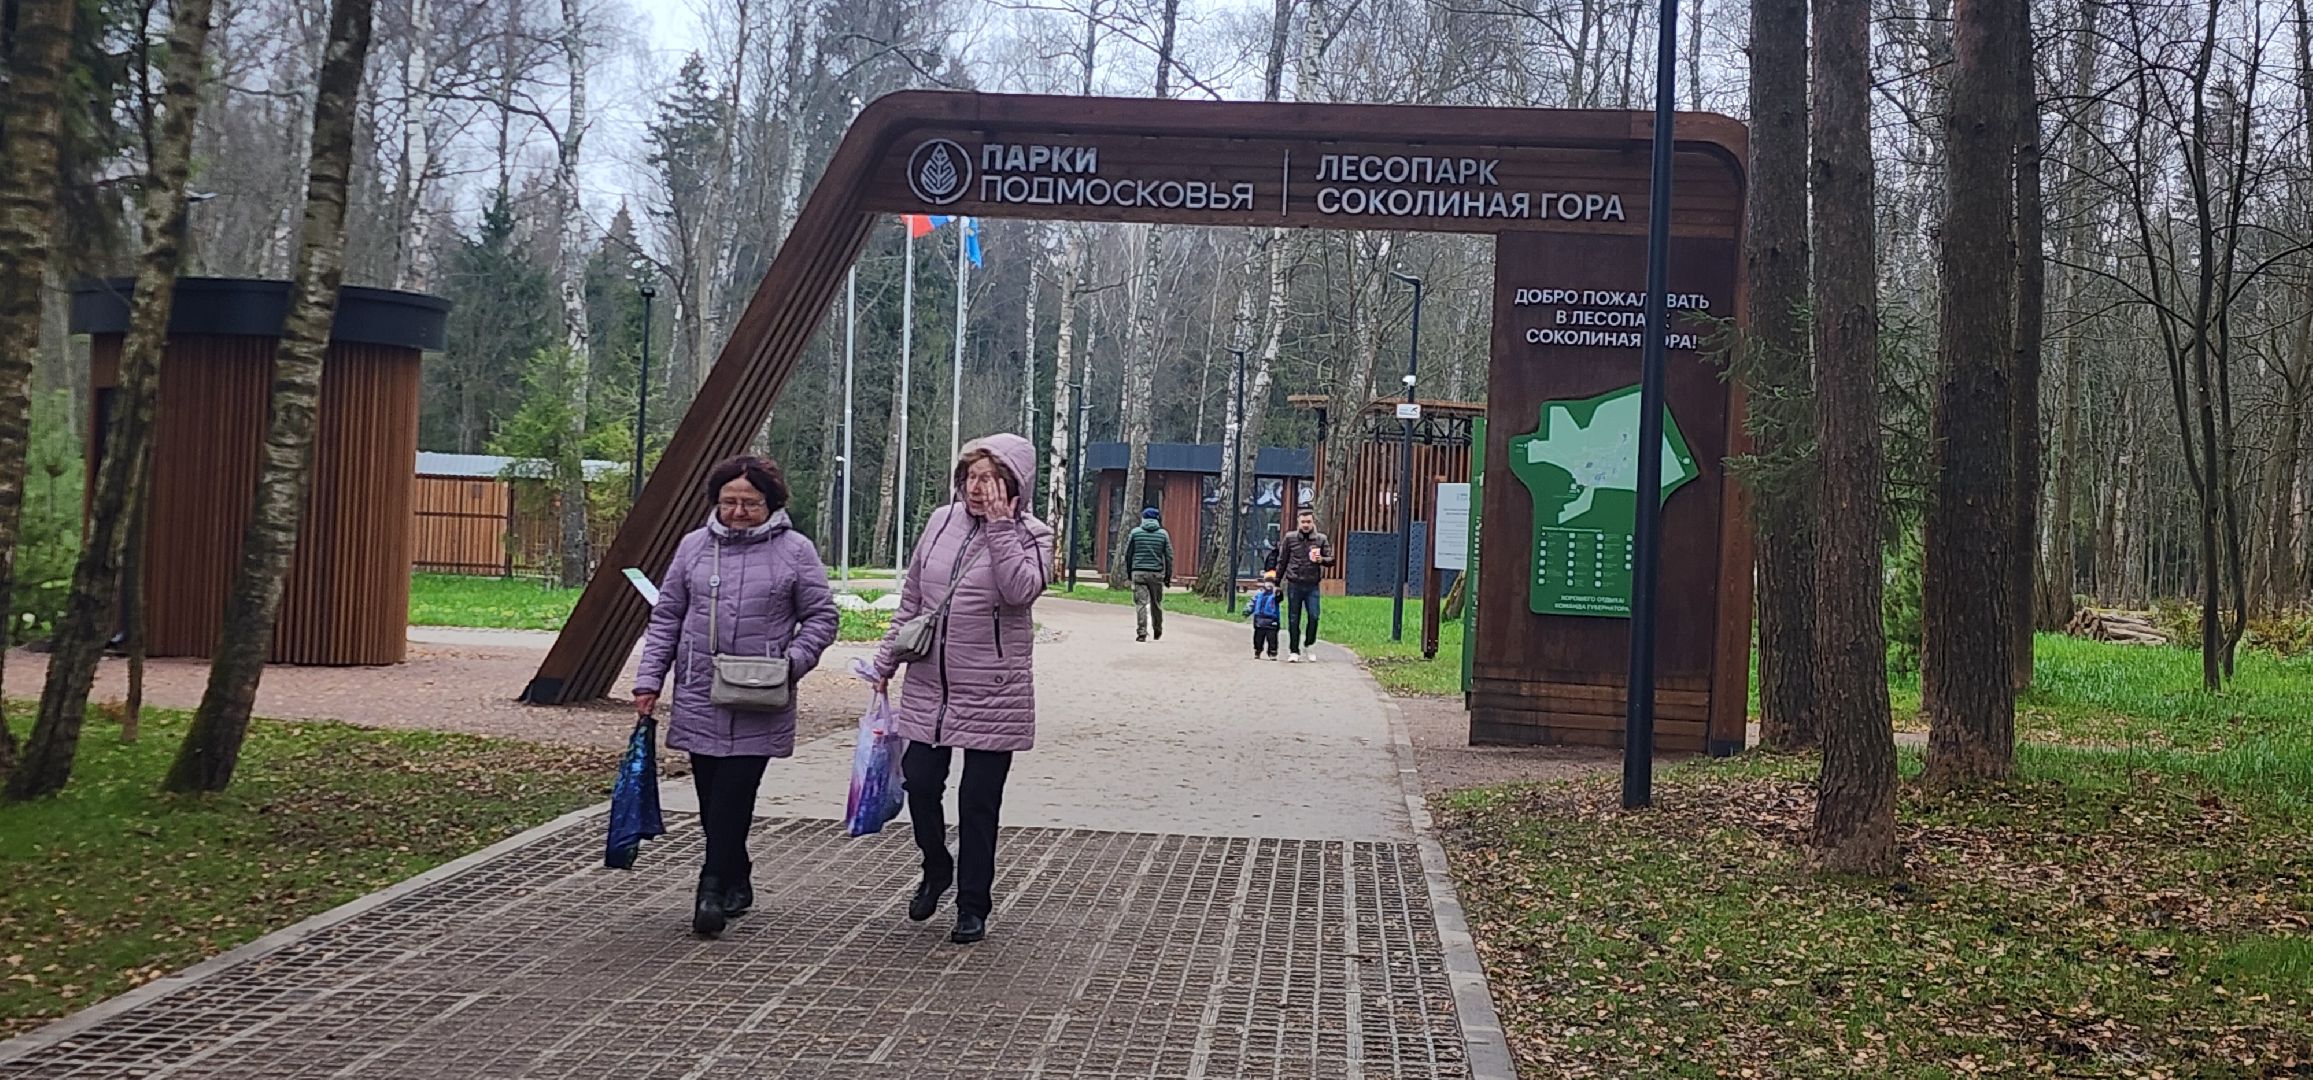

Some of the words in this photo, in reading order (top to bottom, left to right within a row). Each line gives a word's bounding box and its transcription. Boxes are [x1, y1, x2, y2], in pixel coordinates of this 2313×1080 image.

[982, 144, 1097, 174] ПАРКИ
[1316, 154, 1499, 185] ЛЕСОПАРК
[981, 175, 1254, 210] ПОДМОСКОВЬЯ
[1317, 188, 1530, 218] СОКОЛИНАЯ
[1541, 193, 1625, 221] ГОРА
[1515, 289, 1578, 305] ДОБРО
[1583, 291, 1709, 308] ПОЖАЛВАТЬ
[1556, 311, 1567, 324] В
[1571, 311, 1671, 328] ЛЕСОПА
[1526, 329, 1641, 347] СОКОЛИНАЯ
[1665, 334, 1697, 349] РА!
